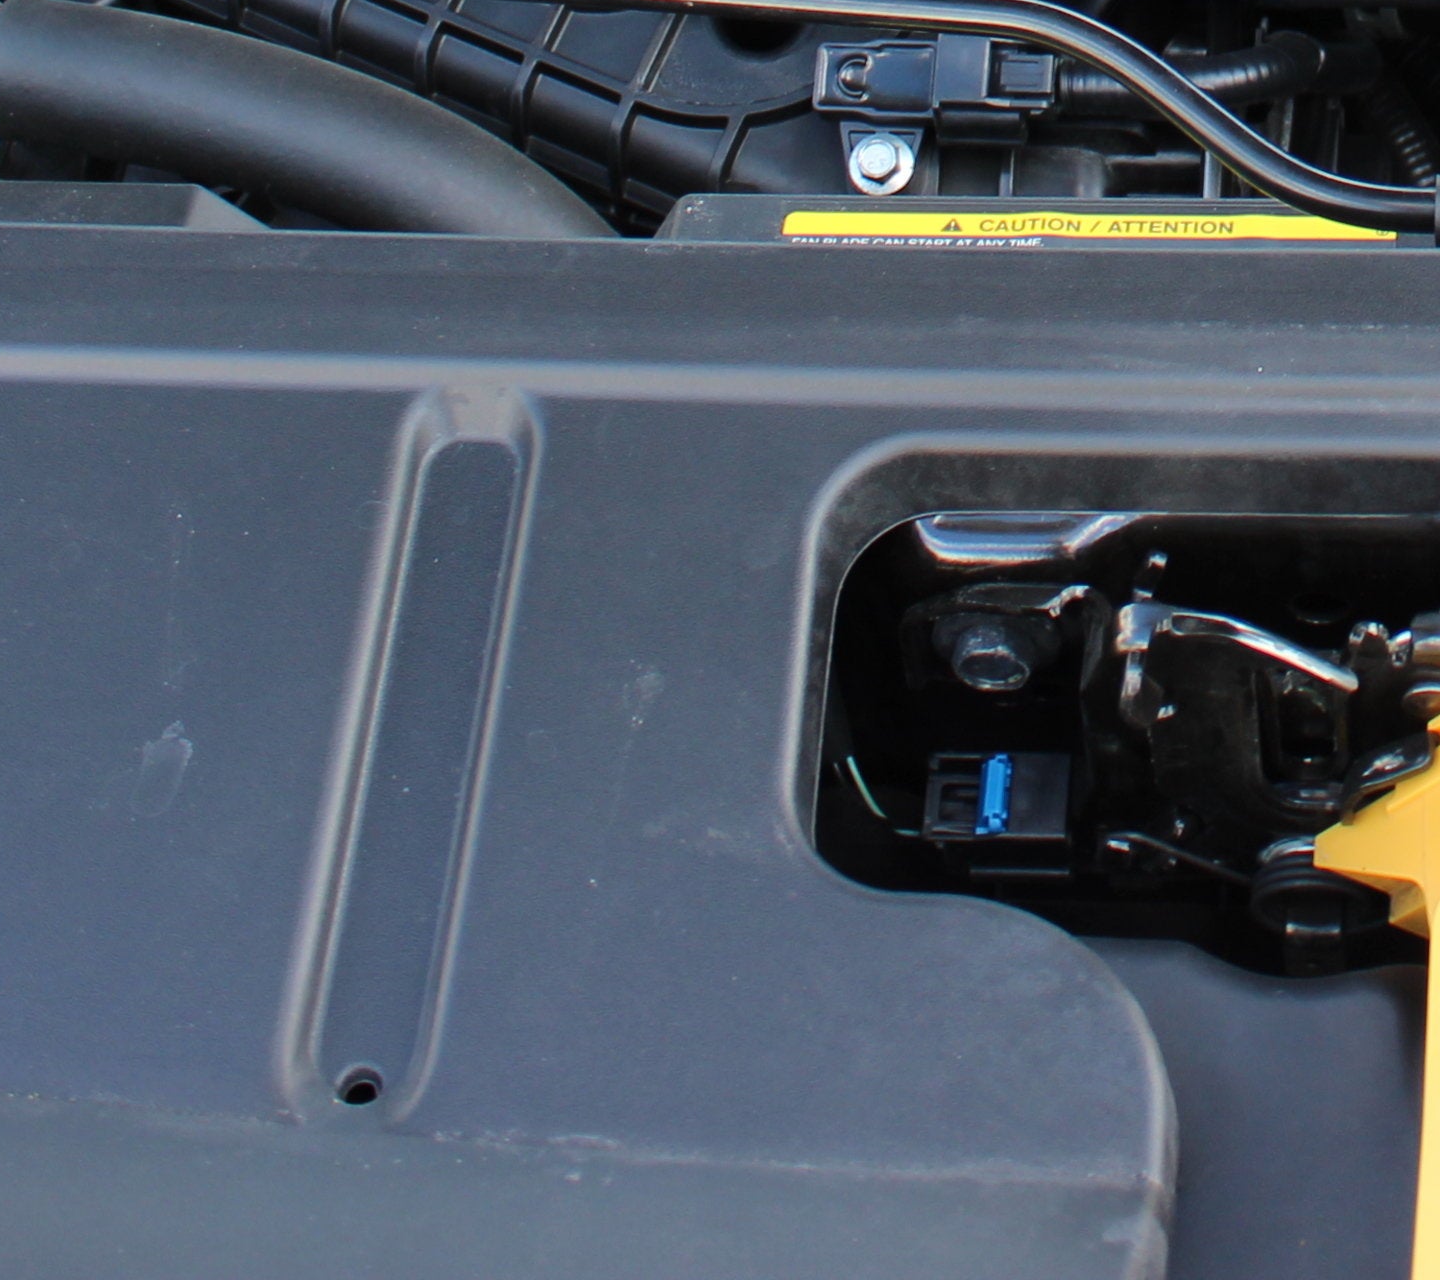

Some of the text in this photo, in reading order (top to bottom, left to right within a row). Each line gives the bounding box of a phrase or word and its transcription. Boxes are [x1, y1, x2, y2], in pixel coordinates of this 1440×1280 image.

[978, 217, 1235, 234] CAUTION / ATTENTION
